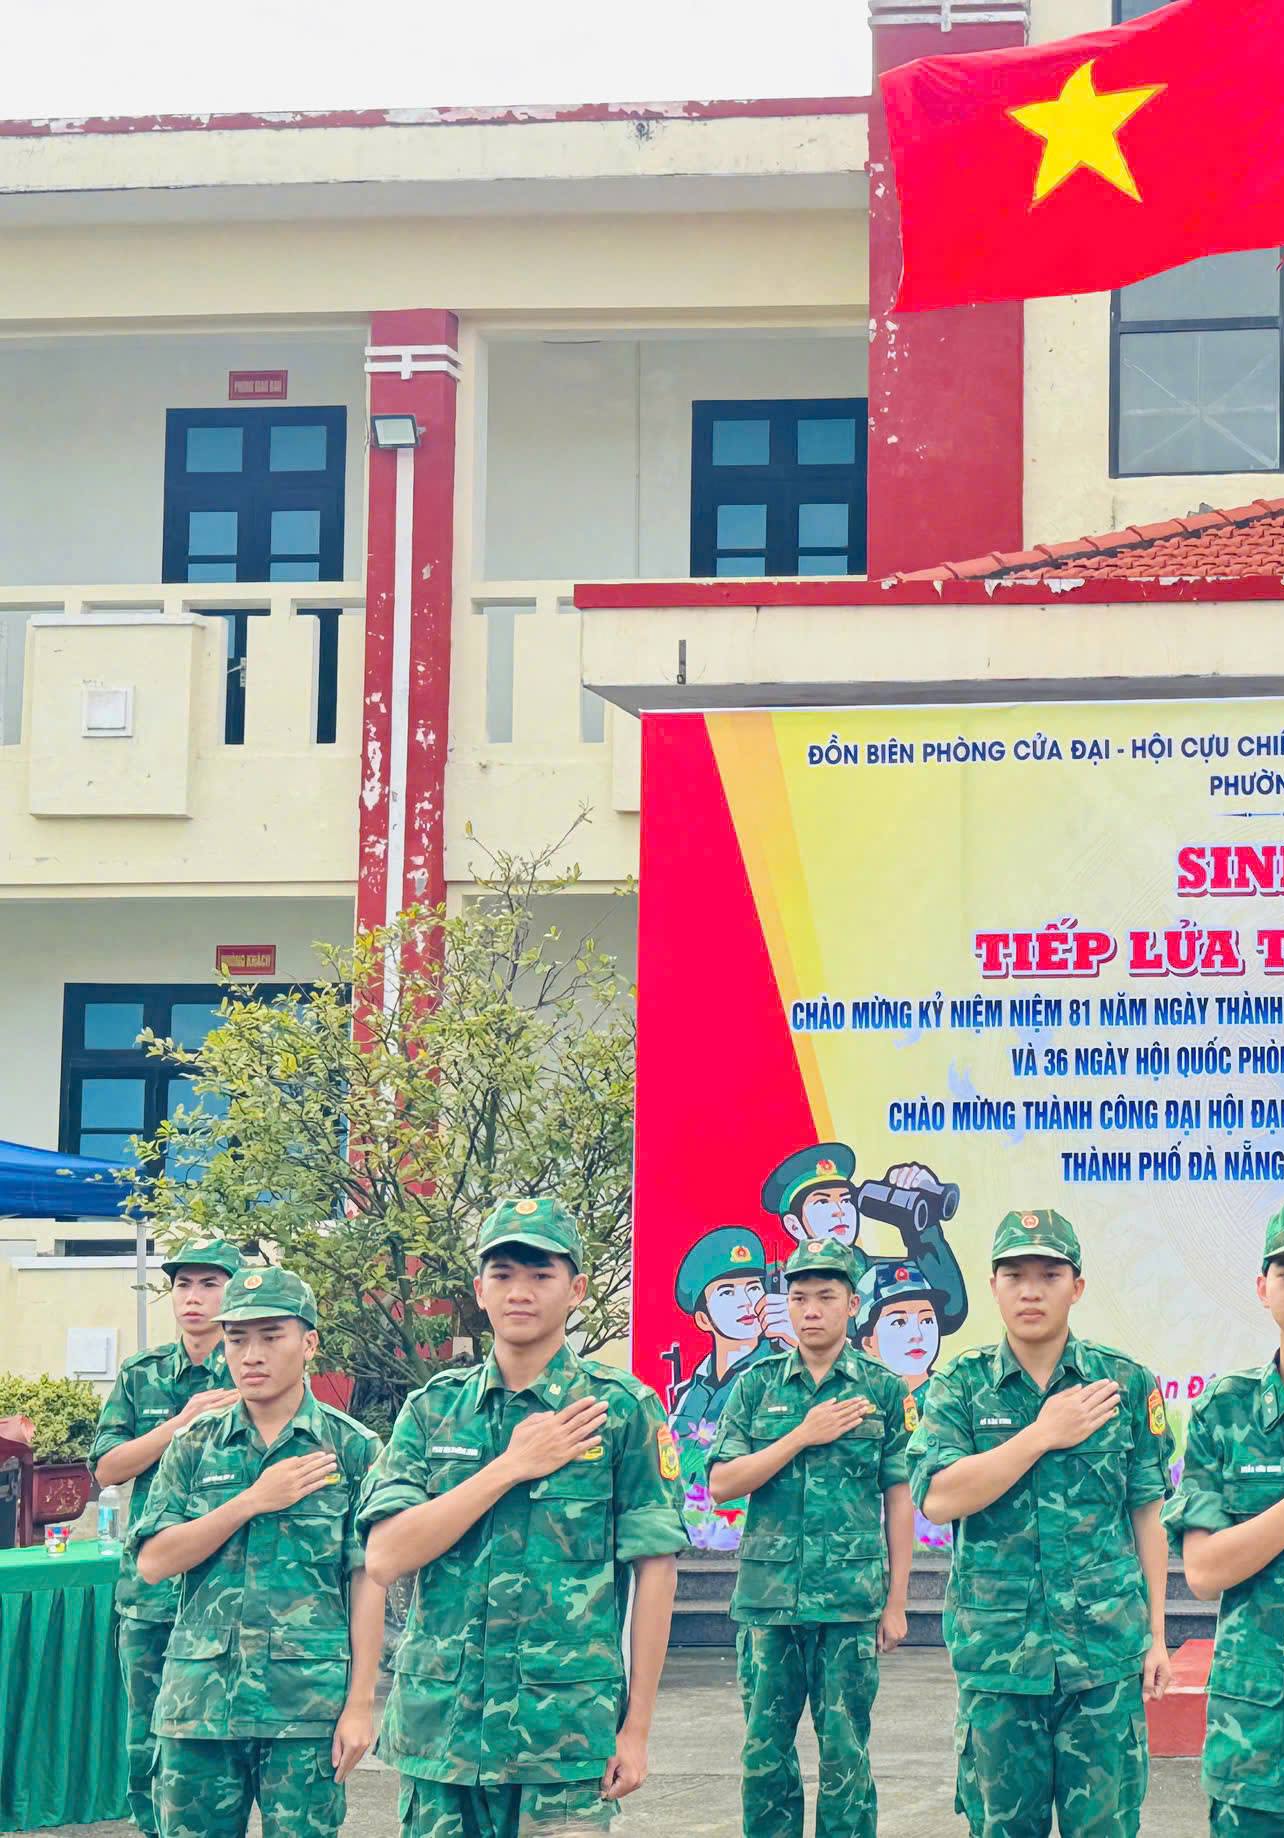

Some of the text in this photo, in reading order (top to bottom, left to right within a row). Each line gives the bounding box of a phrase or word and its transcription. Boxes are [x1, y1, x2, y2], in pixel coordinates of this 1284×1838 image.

[807, 734, 858, 765] ĐỒN
[867, 737, 914, 764] BIÊN
[922, 735, 1006, 763] PHÒNG
[1013, 732, 1063, 761] CỬA
[1070, 739, 1110, 766] ĐẠI
[1131, 732, 1173, 765] HỘI
[1180, 733, 1229, 764] CỰU
[975, 917, 1118, 979] TIẾP
[1129, 918, 1245, 978] LỬA
[792, 995, 846, 1031] CHÀO
[851, 995, 913, 1030] MỪNG
[918, 990, 944, 1029] KỶ
[950, 993, 1003, 1034] NIỆM
[1009, 992, 1063, 1034] NIỆM
[1068, 998, 1091, 1027] 81
[1099, 991, 1148, 1027] NĂM
[1153, 991, 1209, 1026] NGÀY
[1214, 990, 1284, 1025] THÀNH
[1011, 1041, 1038, 1077] VÀ
[1043, 1048, 1069, 1077] 36
[1074, 1041, 1130, 1076] NGÀY
[1135, 1040, 1170, 1082] HỘI
[1176, 1036, 1232, 1079] QUỐC
[888, 1095, 945, 1132] CHÀO
[951, 1094, 1016, 1132] MỪNG
[1022, 1094, 1093, 1131] THÀNH
[1099, 1093, 1159, 1131] CÔNG
[1164, 1099, 1201, 1137] ĐẠI
[1208, 1092, 1245, 1136] HỘI
[1061, 1145, 1132, 1182] THÀNH
[1138, 1140, 1182, 1182] PHỐ
[1187, 1144, 1218, 1181] ĐÀ
